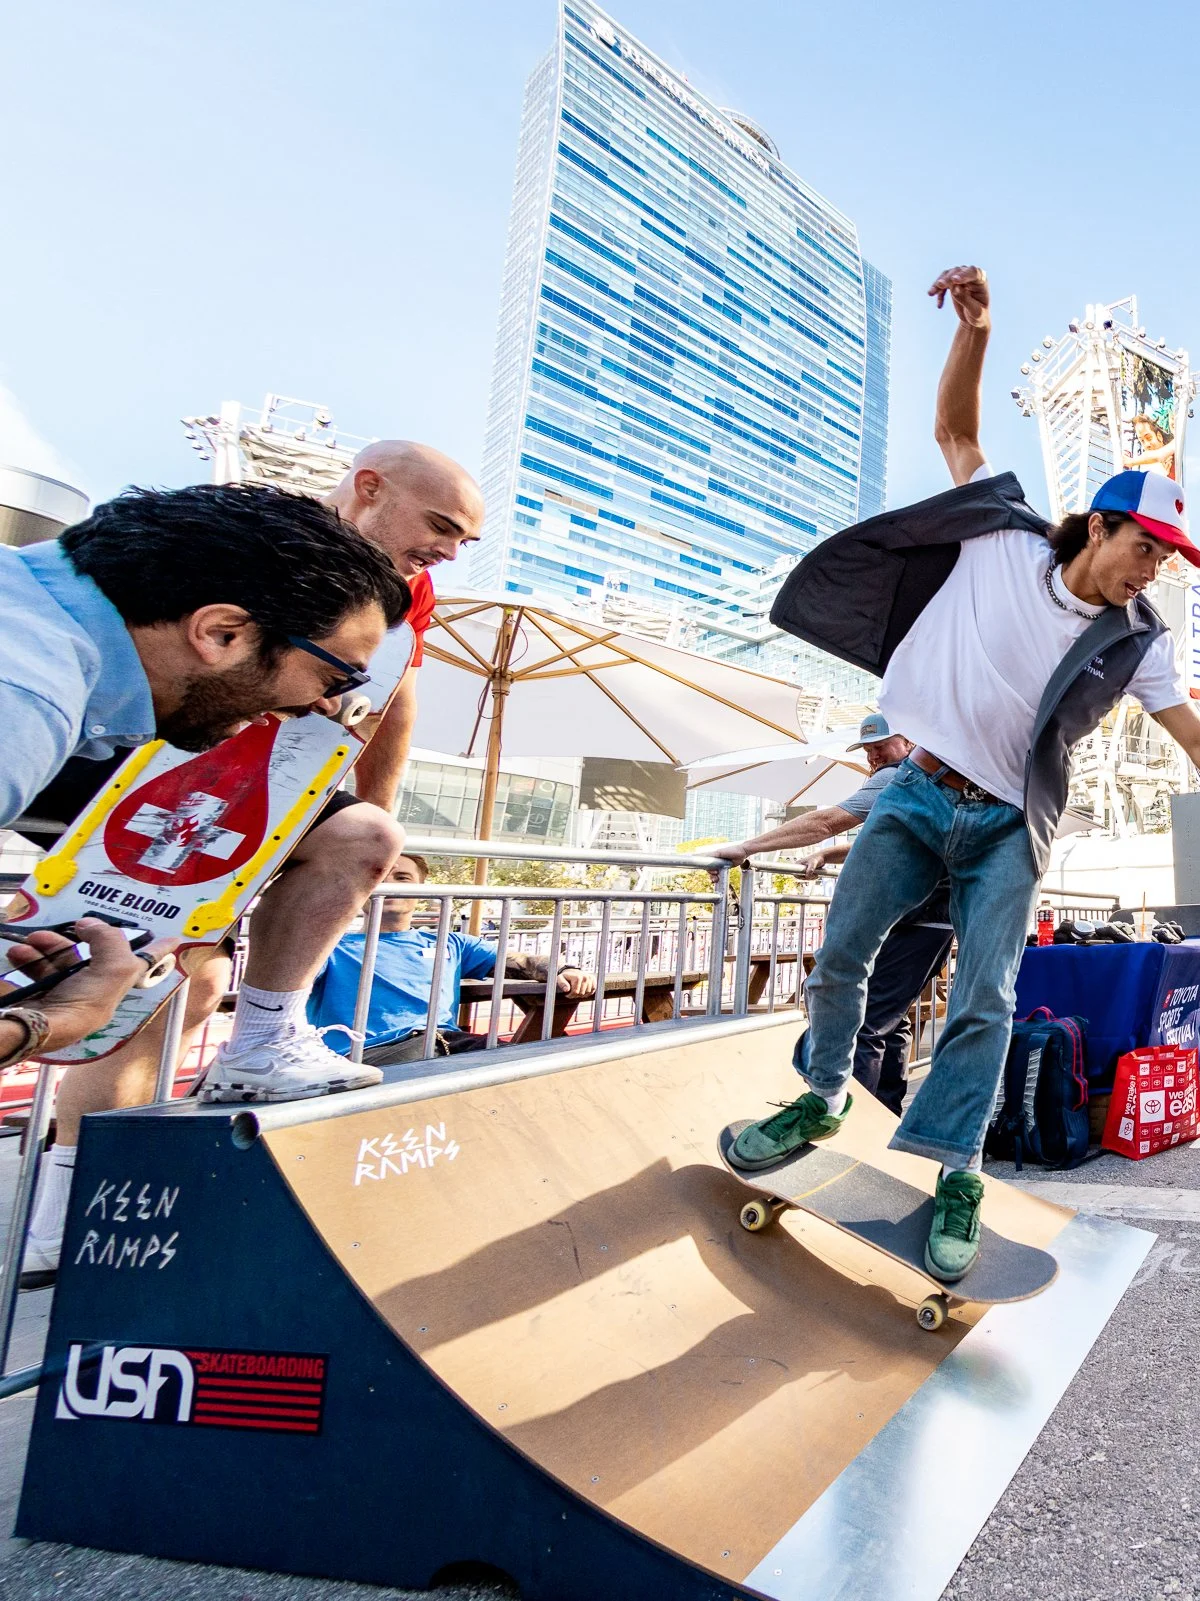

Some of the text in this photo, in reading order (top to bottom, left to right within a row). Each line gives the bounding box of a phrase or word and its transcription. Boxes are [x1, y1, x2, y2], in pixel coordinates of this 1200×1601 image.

[78, 880, 181, 919] GIVE BLOOD
[1170, 985, 1199, 1006] TOYOTA
[1168, 1090, 1184, 1100] we
[1169, 1090, 1197, 1117] easy
[357, 1121, 449, 1162] KEEN
[354, 1139, 461, 1186] RAMPS
[85, 1178, 181, 1223] KEEN
[74, 1229, 180, 1270] RAMPS
[197, 1352, 324, 1380] SKATEBOARDING
